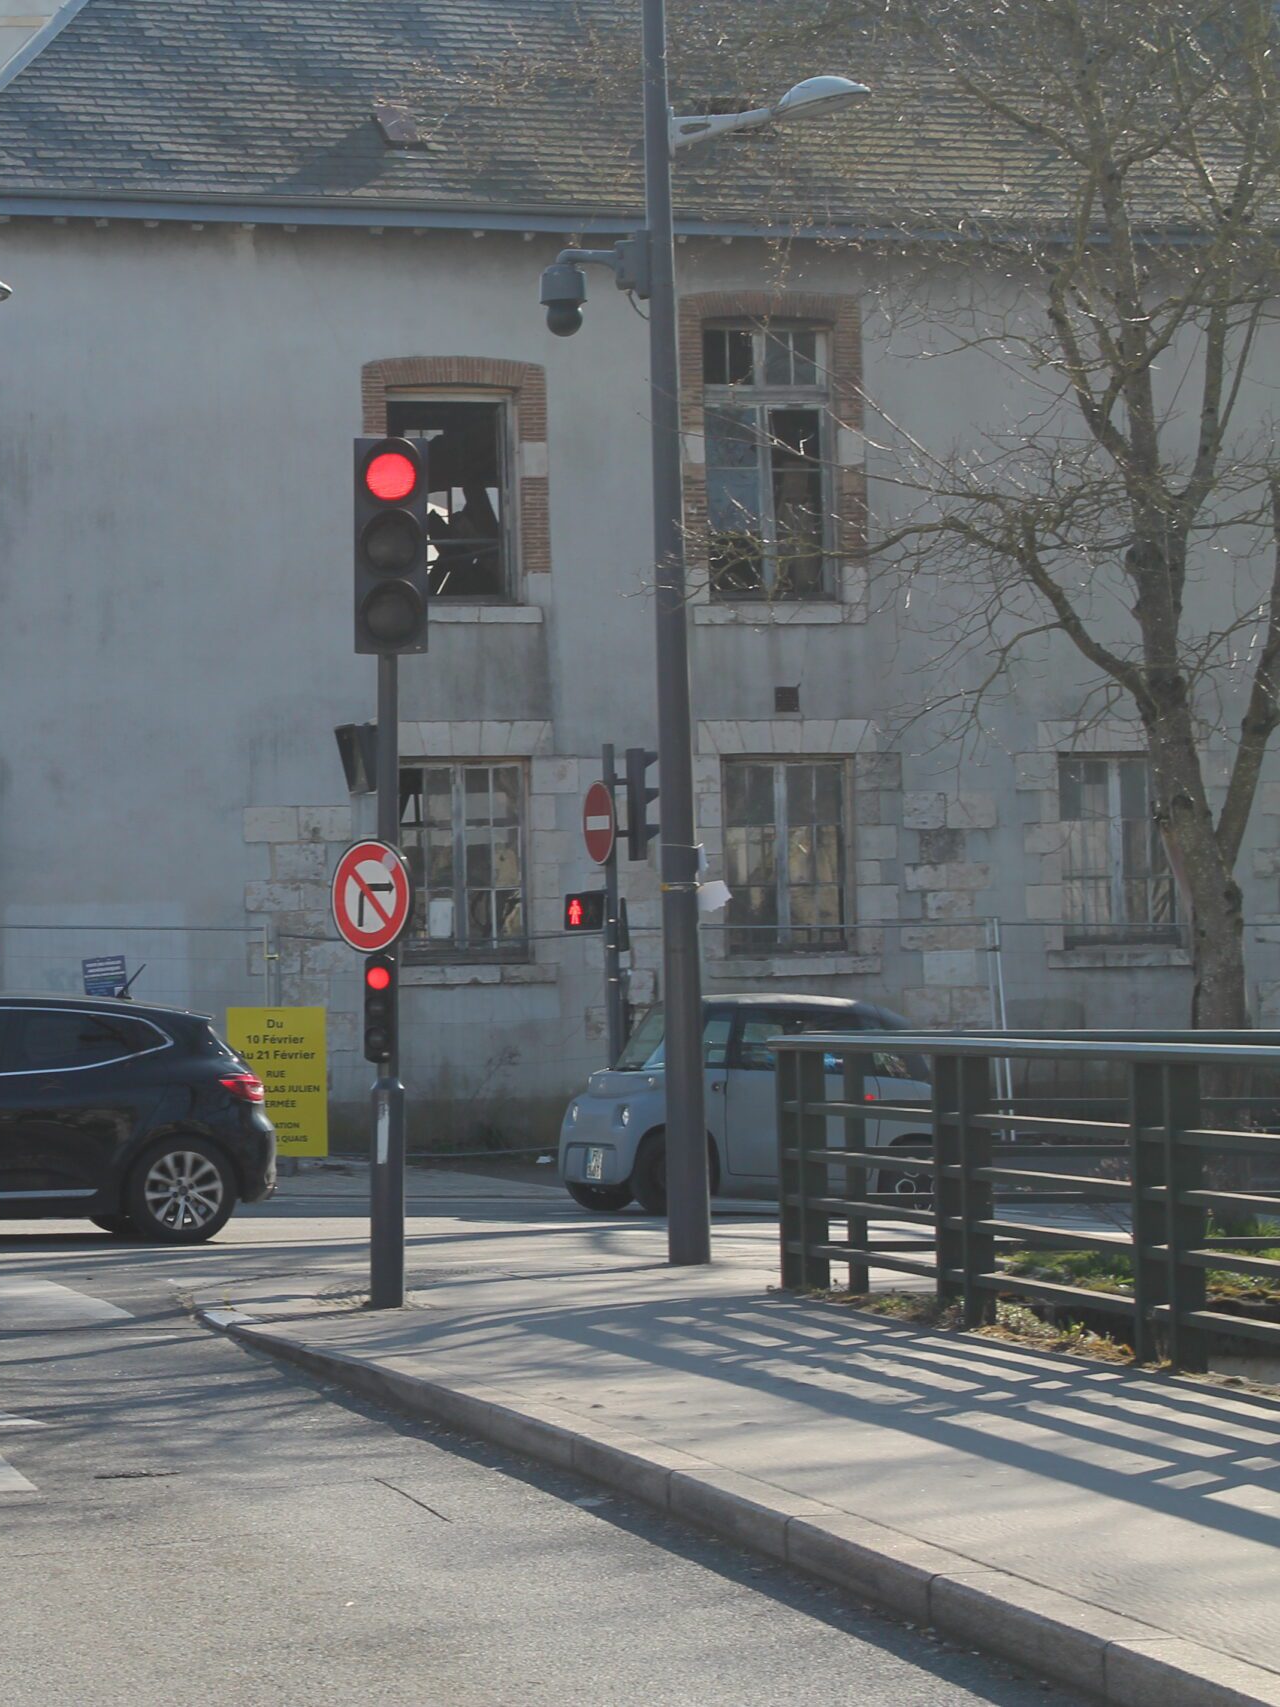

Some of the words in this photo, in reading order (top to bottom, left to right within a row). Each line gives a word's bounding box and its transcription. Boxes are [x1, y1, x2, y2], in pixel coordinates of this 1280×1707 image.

[266, 1019, 284, 1028] Du
[246, 1035, 260, 1044] 10
[262, 1034, 305, 1044] Février
[257, 1050, 270, 1060] 21
[273, 1050, 316, 1060] Février
[266, 1070, 286, 1078] RUE
[287, 1085, 320, 1093] JULIEN
[281, 1135, 308, 1143] QUAIS
